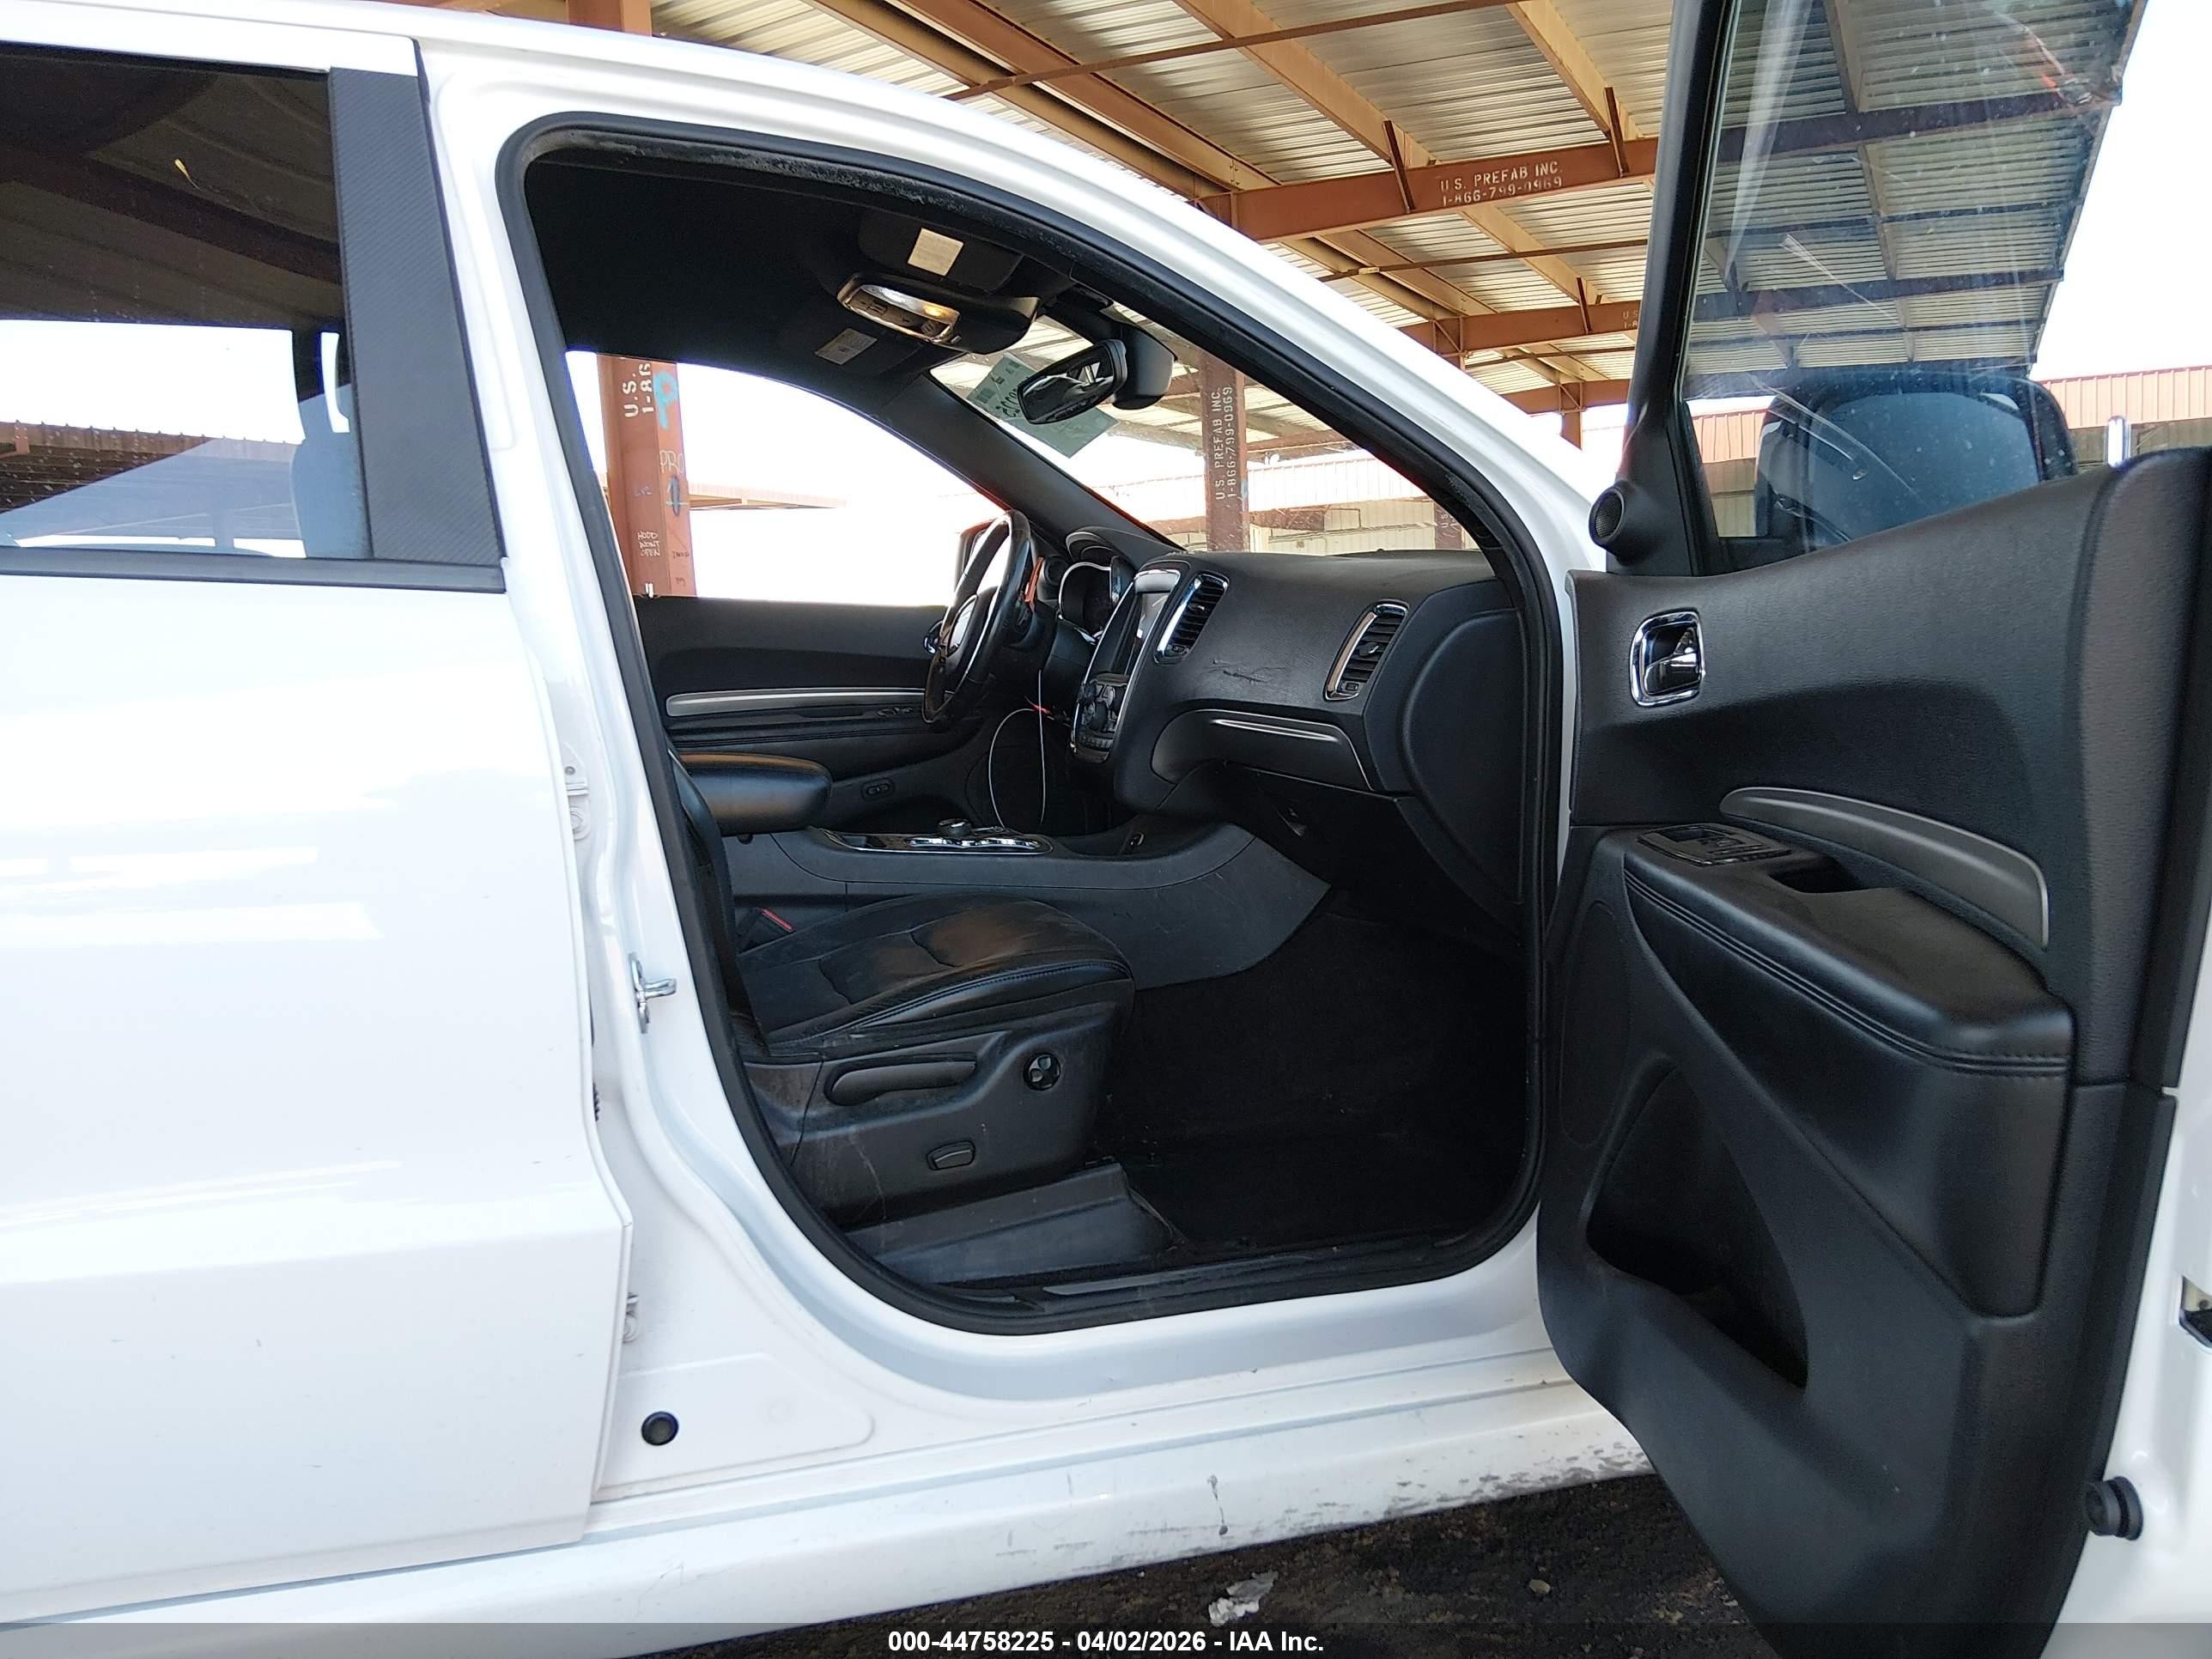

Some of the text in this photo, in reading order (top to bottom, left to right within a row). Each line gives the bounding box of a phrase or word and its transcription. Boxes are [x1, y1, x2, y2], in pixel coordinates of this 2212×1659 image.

[1474, 166, 1528, 187] PREFAB
[1534, 161, 1563, 177] INC.
[622, 373, 639, 418] U.S.
[1211, 387, 1222, 412] INC.
[1212, 418, 1224, 468] PREFAB
[1223, 386, 1237, 498] 1-866-799-0969
